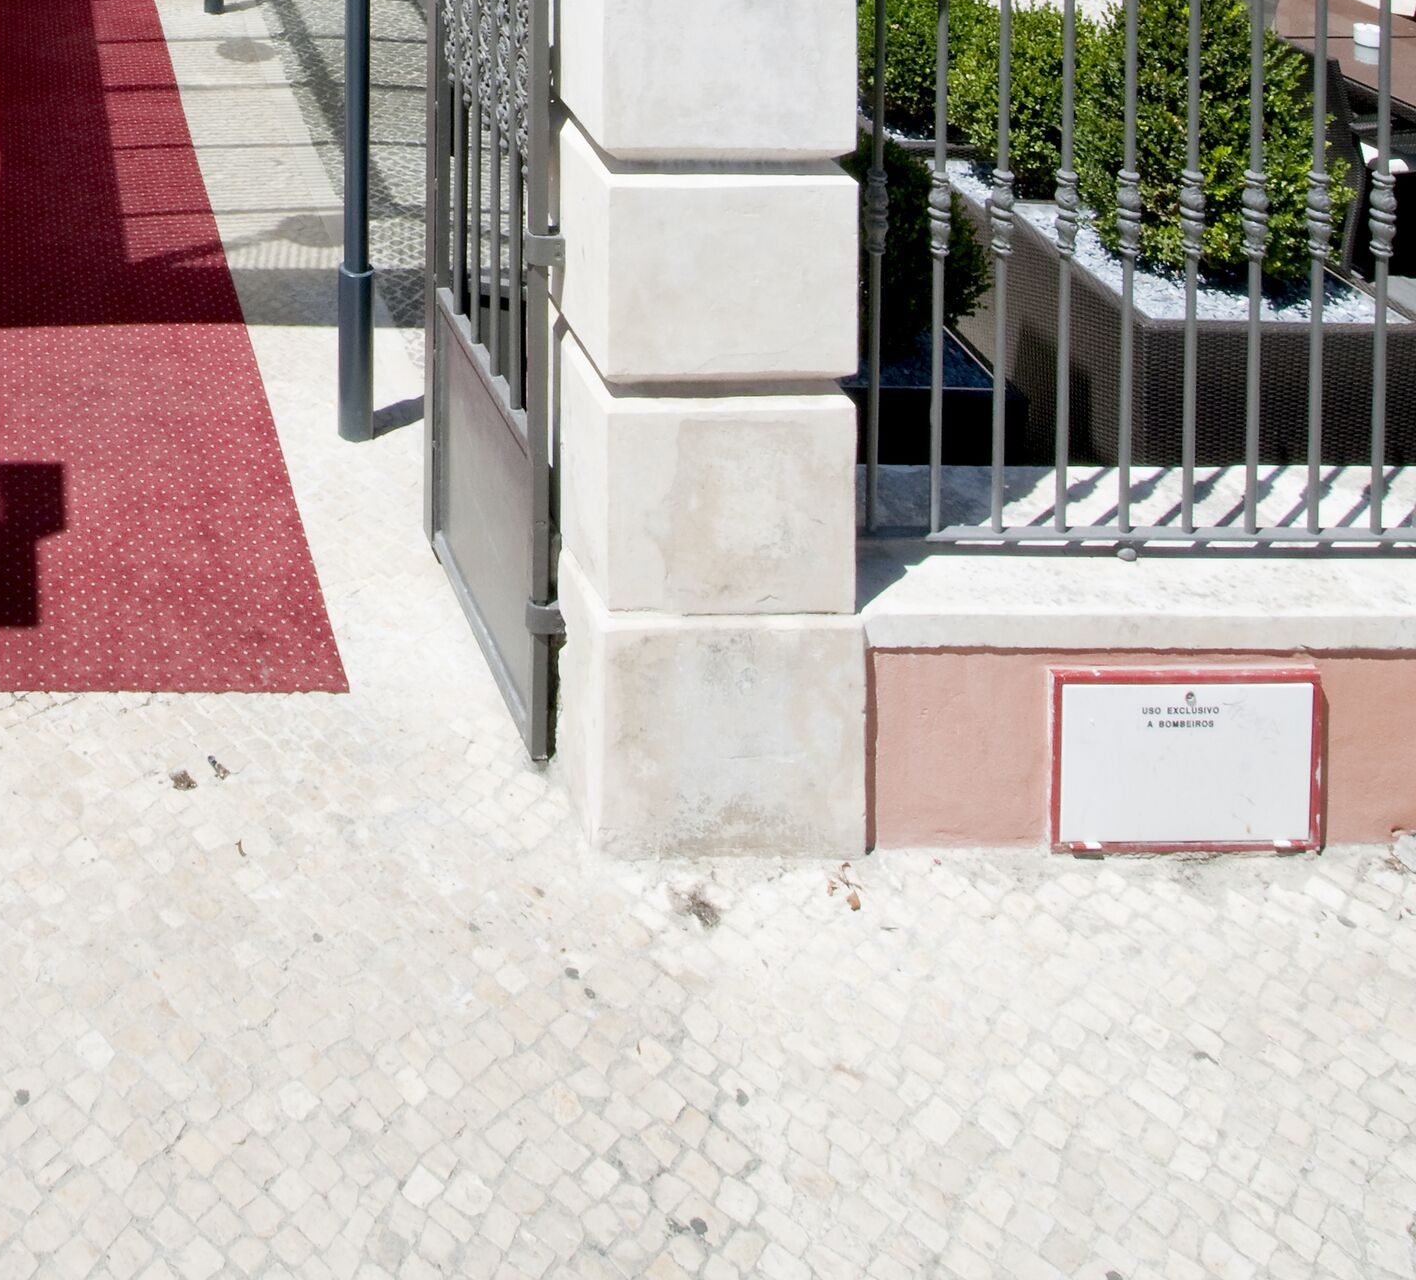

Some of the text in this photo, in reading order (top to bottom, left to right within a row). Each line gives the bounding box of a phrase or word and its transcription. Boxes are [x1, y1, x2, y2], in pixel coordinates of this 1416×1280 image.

[1141, 706, 1220, 715] USO EXCLUSIVO
[1147, 720, 1214, 728] A BOMBEIROS
